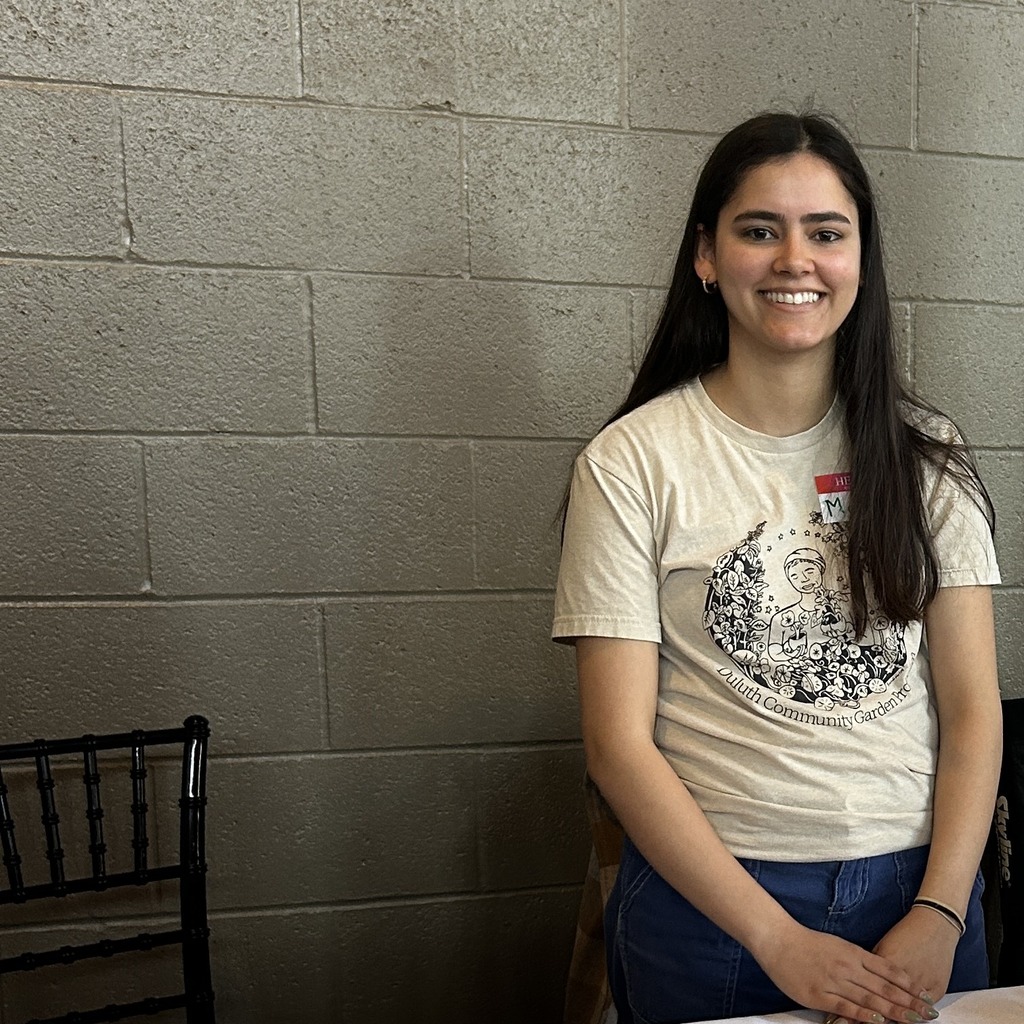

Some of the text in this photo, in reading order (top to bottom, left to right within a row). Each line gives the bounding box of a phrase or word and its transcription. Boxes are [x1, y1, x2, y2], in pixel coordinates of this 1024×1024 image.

[717, 667, 762, 704] Duluth
[763, 697, 853, 730] Community
[854, 698, 898, 724] Garden
